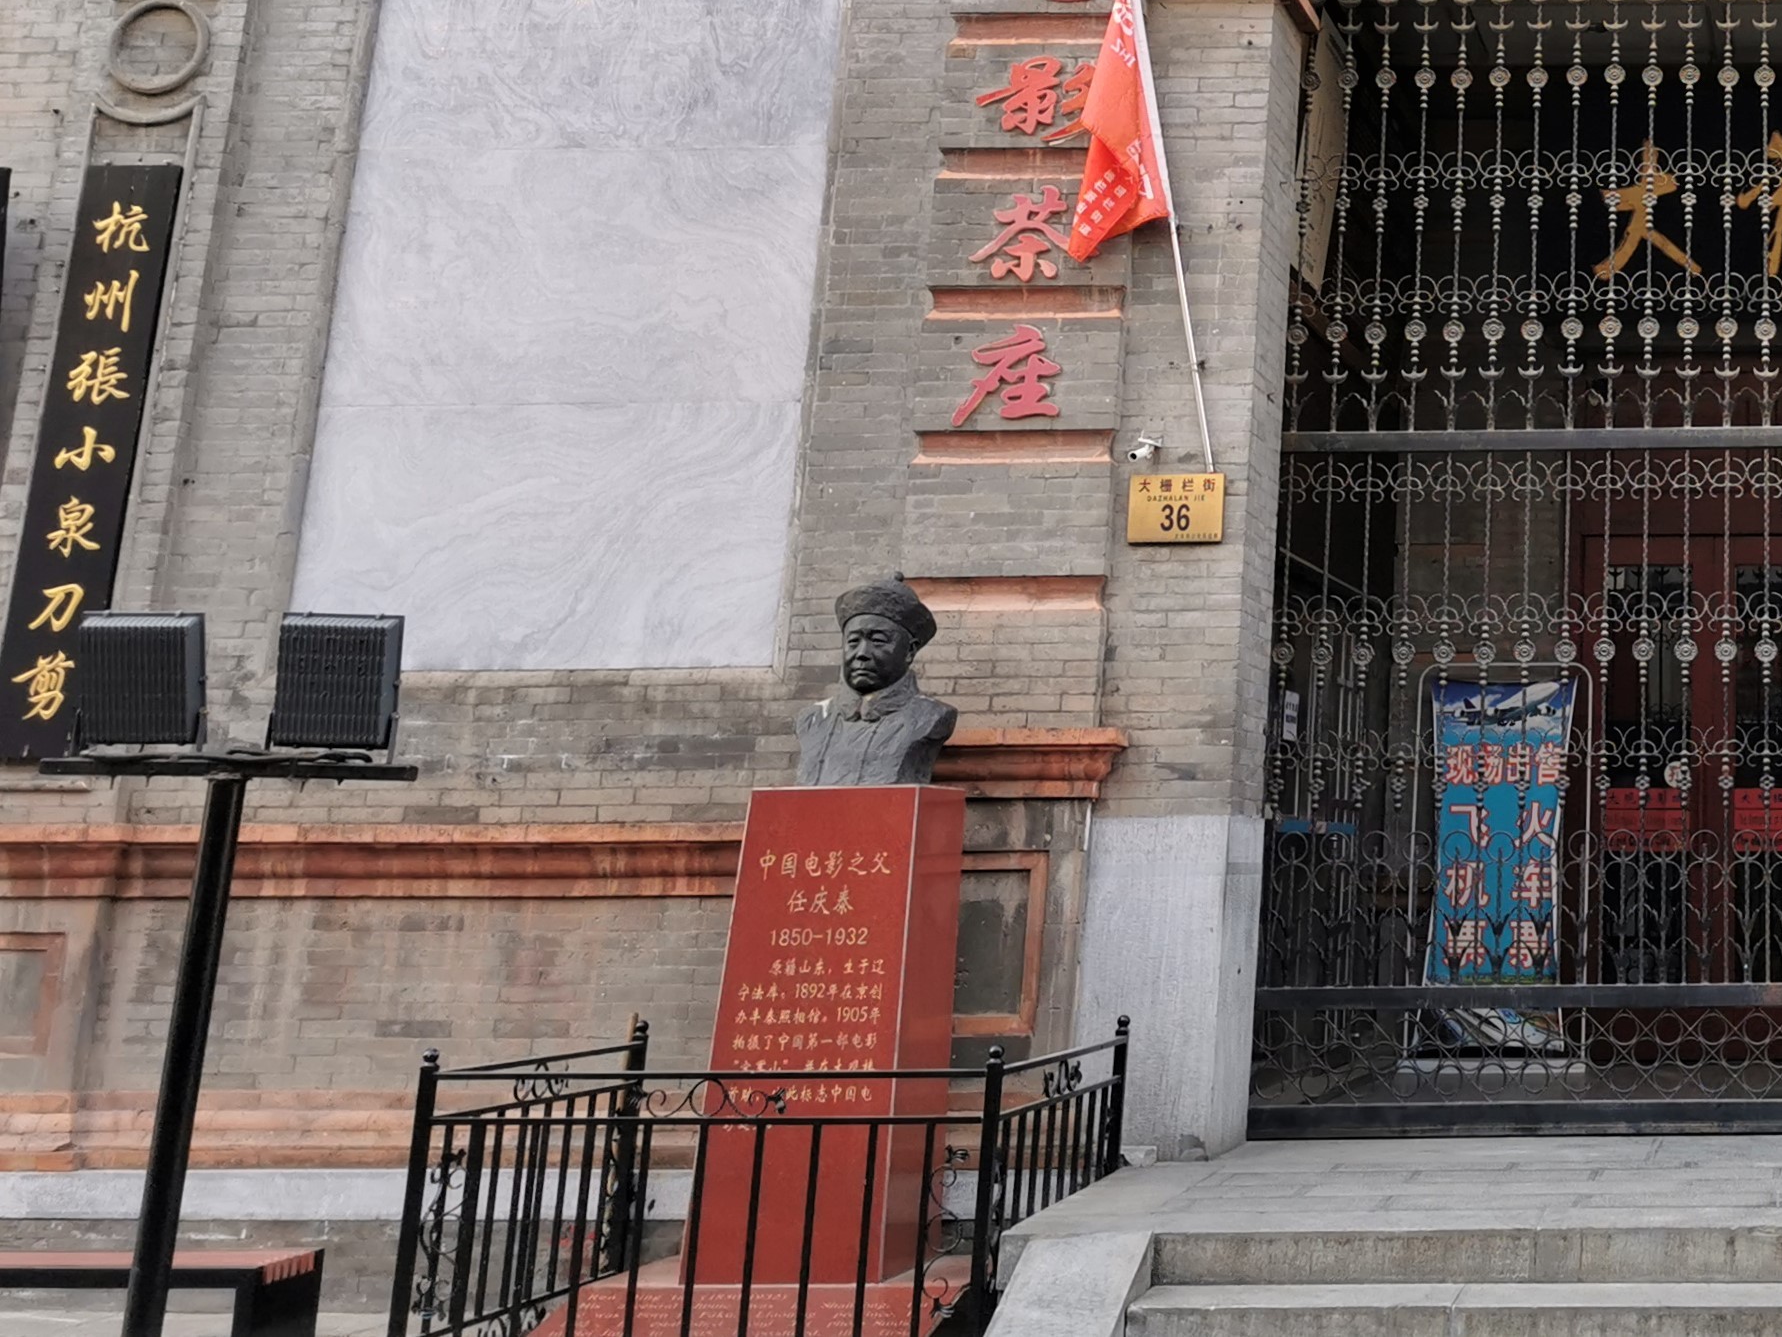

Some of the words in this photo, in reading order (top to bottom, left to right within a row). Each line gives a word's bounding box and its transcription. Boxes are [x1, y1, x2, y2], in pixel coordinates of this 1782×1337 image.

[11, 201, 150, 720] 杭州張小泉刀剪
[1139, 478, 1215, 492] 大栅栏街
[1160, 504, 1190, 531] 36
[1445, 745, 1562, 785] 现场出售
[759, 849, 891, 880] 中国电影之父
[1442, 804, 1490, 968] 飞机票
[1509, 801, 1553, 969] 火车票
[787, 886, 854, 915] 任庆泰
[770, 927, 868, 946] 1850-1932
[732, 1032, 877, 1051] 拍摄了中国第一部电影
